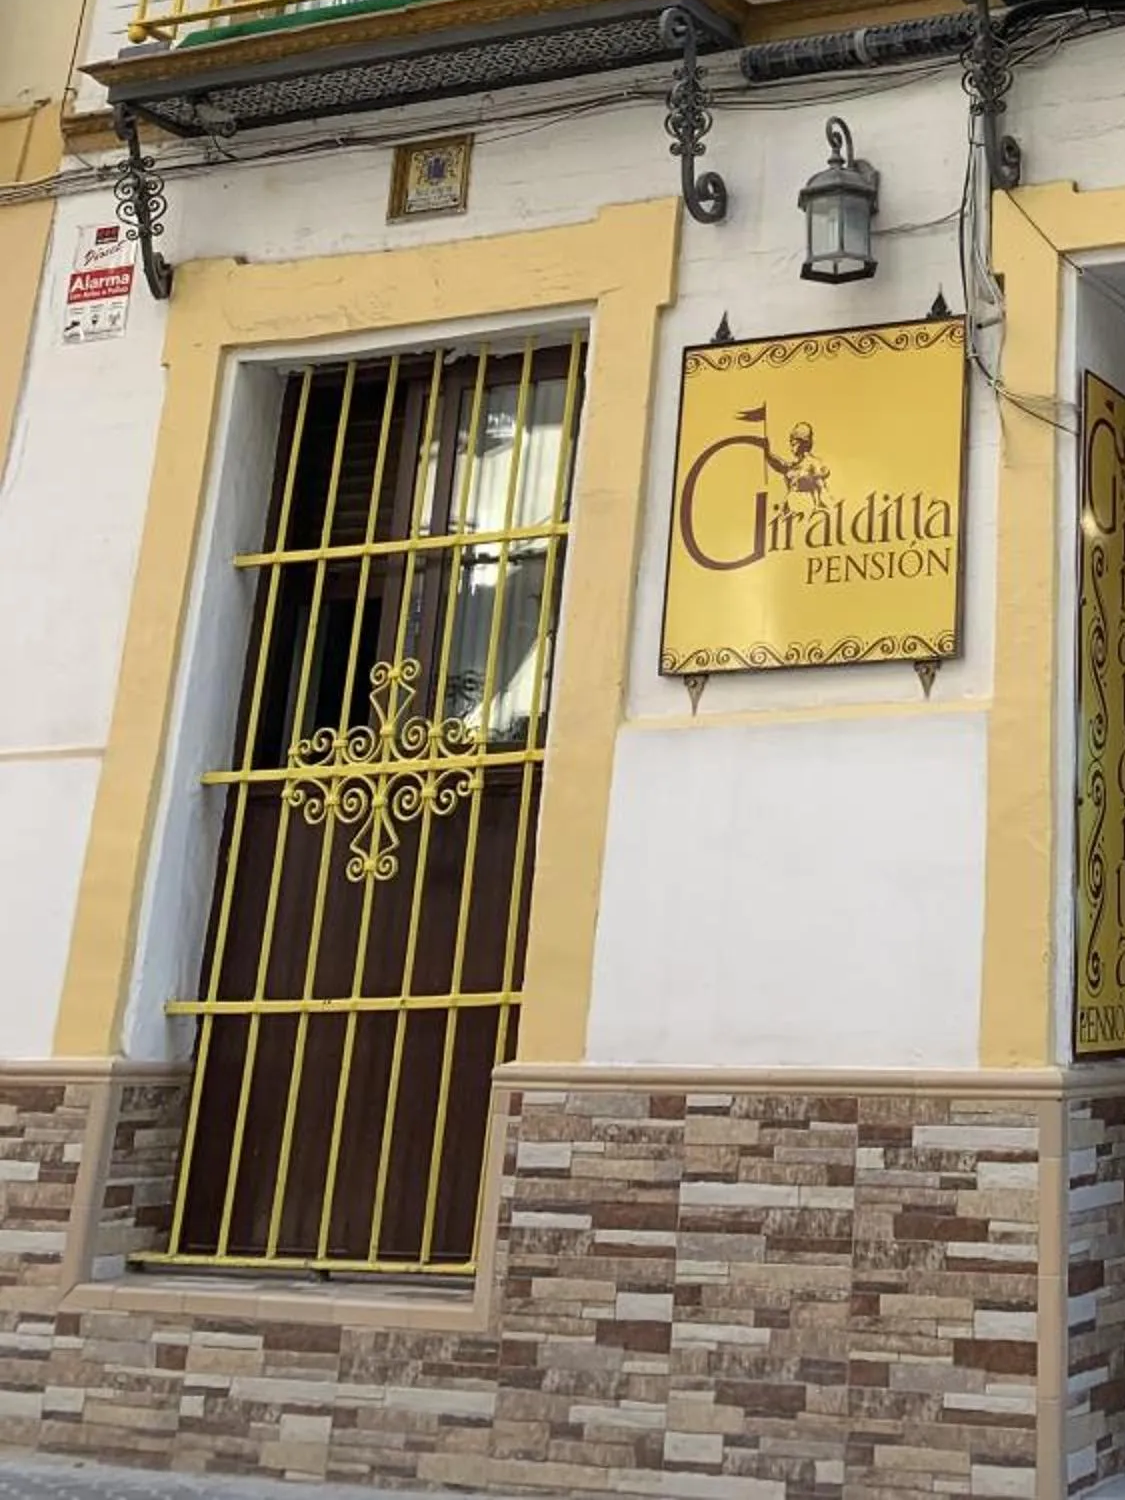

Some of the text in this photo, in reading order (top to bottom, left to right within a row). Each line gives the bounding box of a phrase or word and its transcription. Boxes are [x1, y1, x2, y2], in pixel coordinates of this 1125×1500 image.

[71, 272, 130, 293] Alarma
[680, 434, 952, 572] Giraldilla
[806, 539, 952, 586] PENSIÓN
